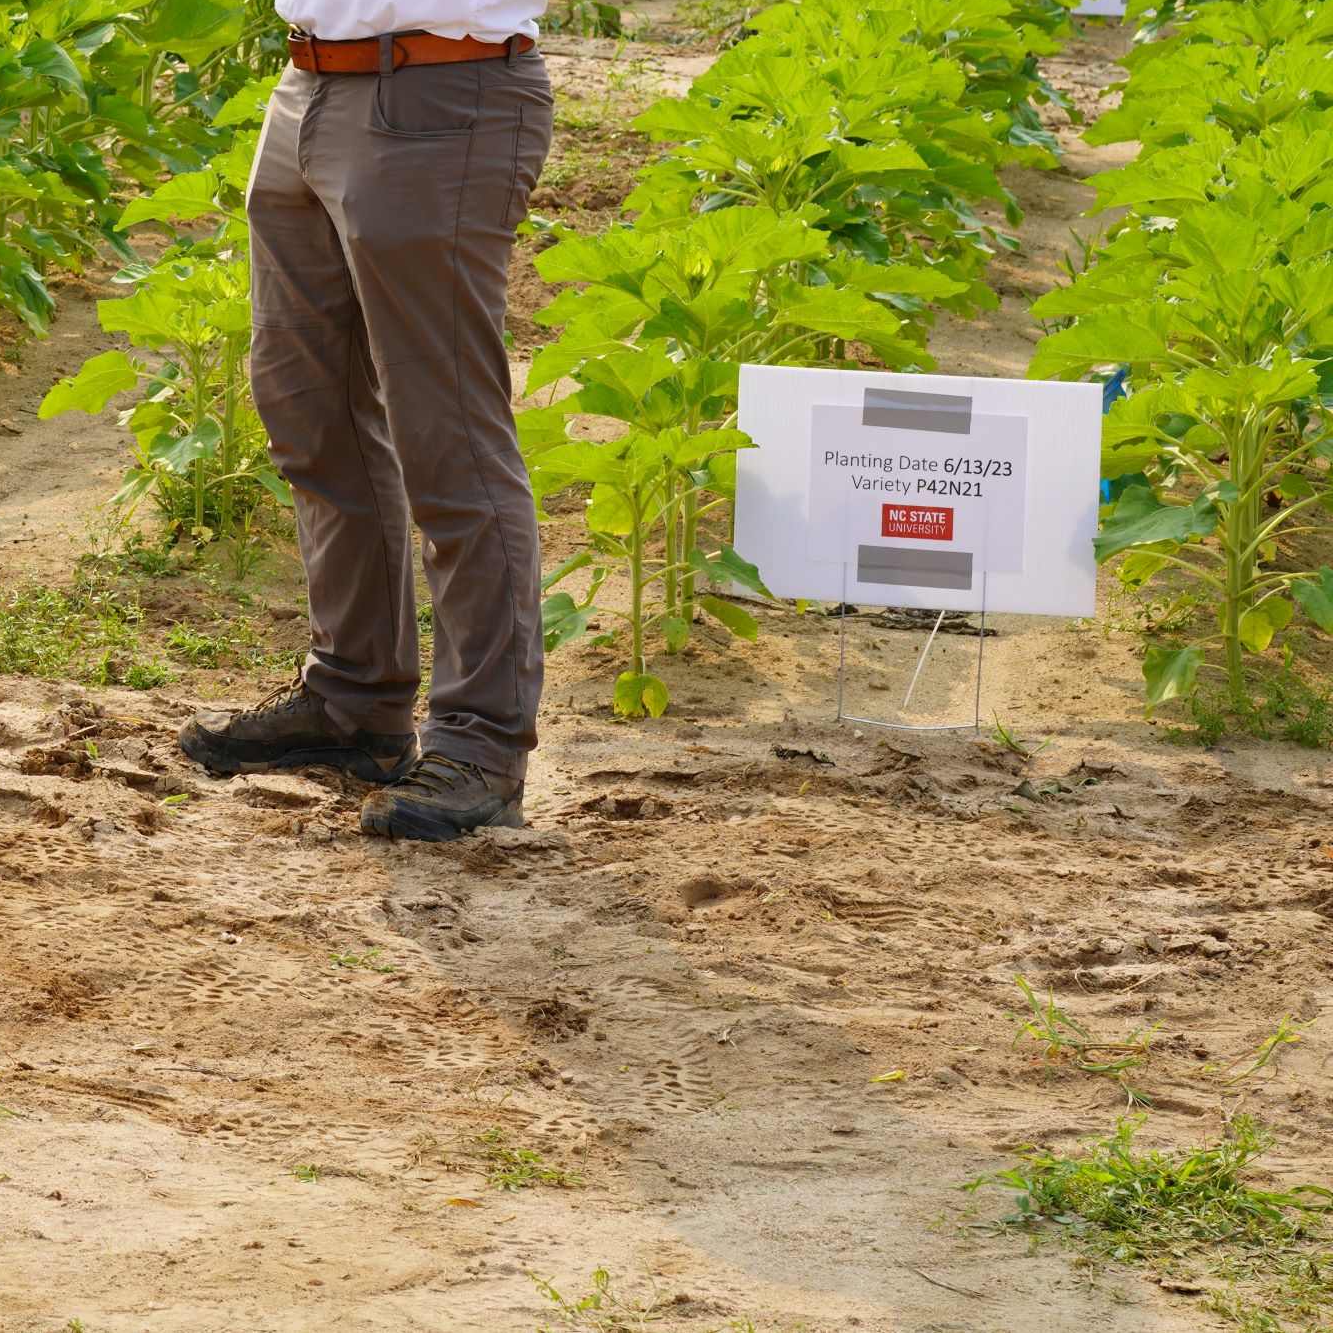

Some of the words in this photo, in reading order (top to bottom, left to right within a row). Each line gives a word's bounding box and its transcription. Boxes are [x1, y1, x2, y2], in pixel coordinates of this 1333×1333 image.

[824, 451, 893, 472] Planting
[899, 455, 938, 472] Date
[943, 457, 1013, 477] 6/13/23
[851, 475, 911, 496] Variety
[916, 478, 983, 497] P42N21
[889, 509, 906, 522] NC
[909, 510, 946, 524] STATE
[888, 522, 946, 535] UNIVERSITY
